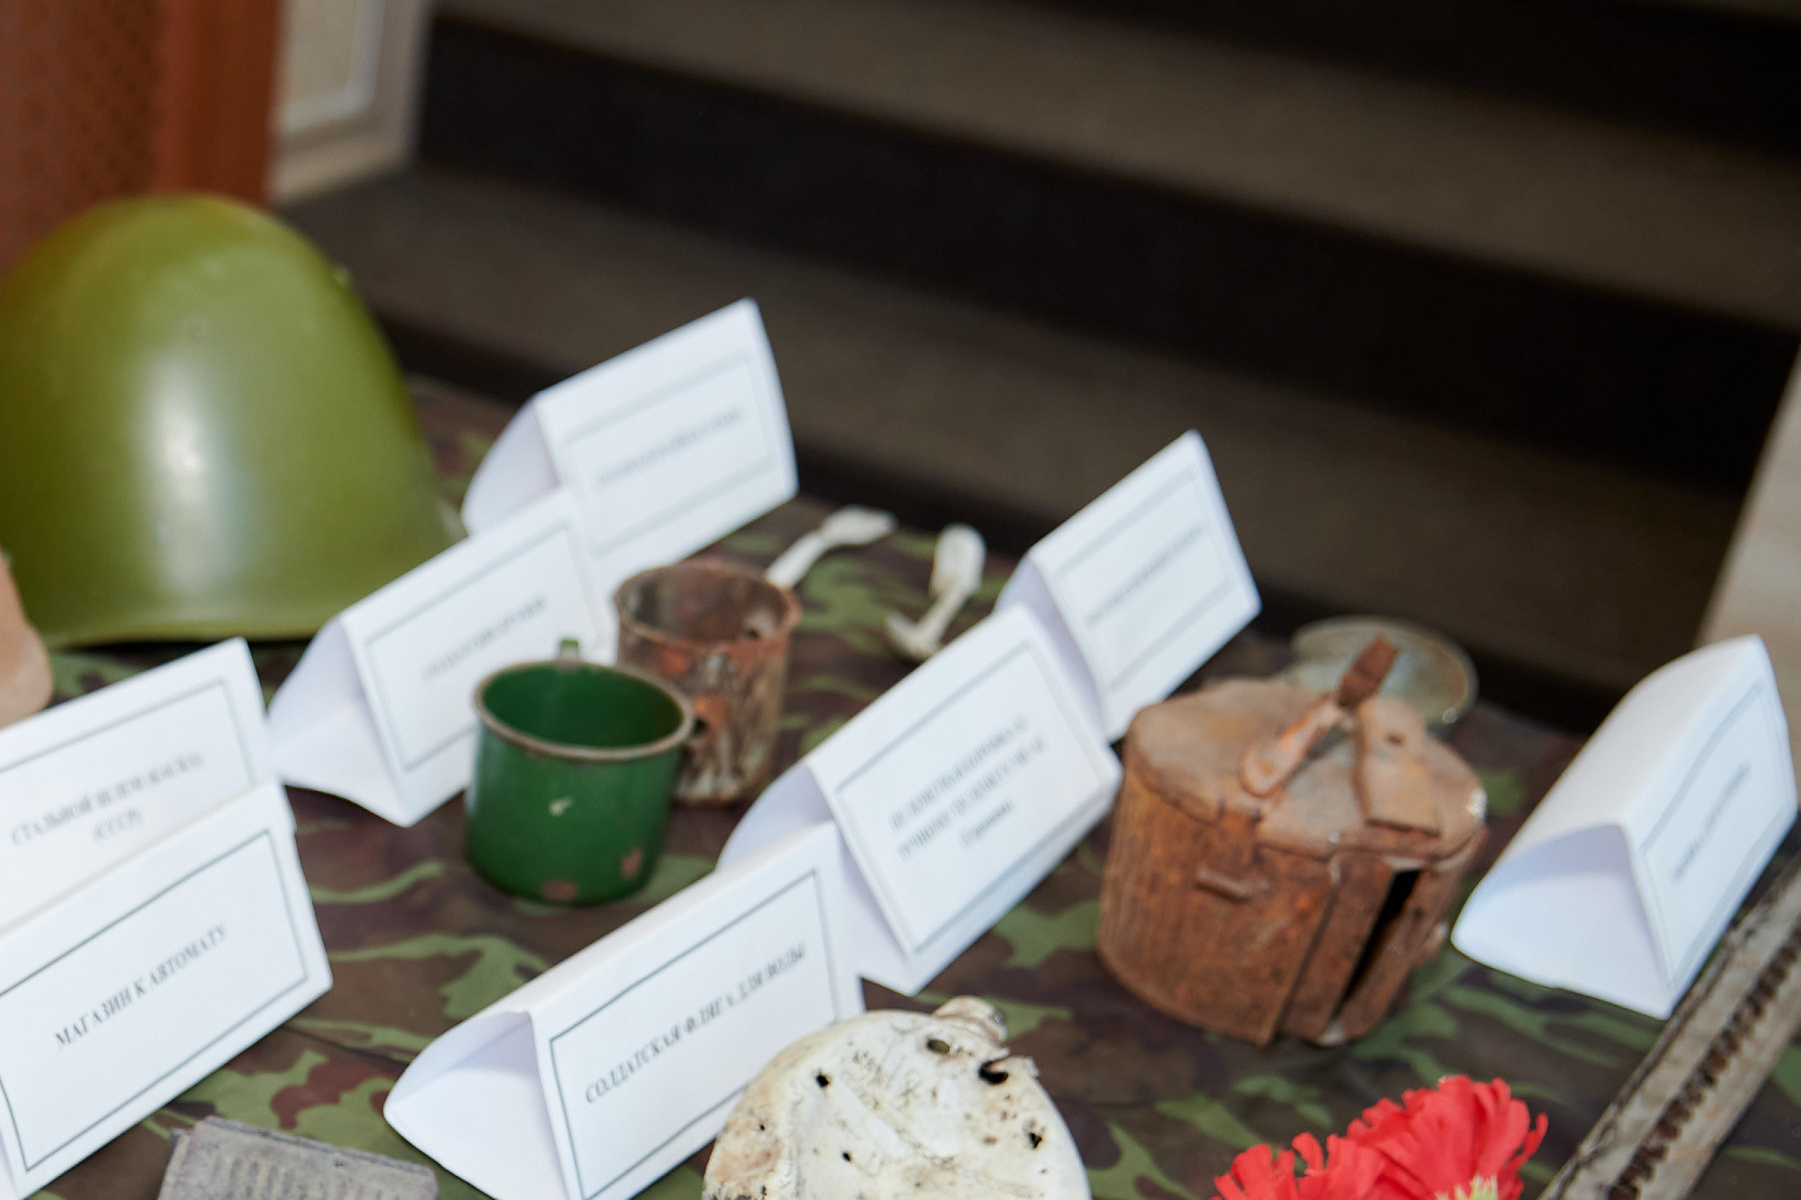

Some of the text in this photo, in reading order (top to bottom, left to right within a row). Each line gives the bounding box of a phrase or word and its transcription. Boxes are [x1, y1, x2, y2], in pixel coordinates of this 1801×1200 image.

[54, 923, 226, 1050] МАГАЗИН К АВТОМАТУ
[585, 1023, 681, 1104] СОЛДАТСКАЯ
